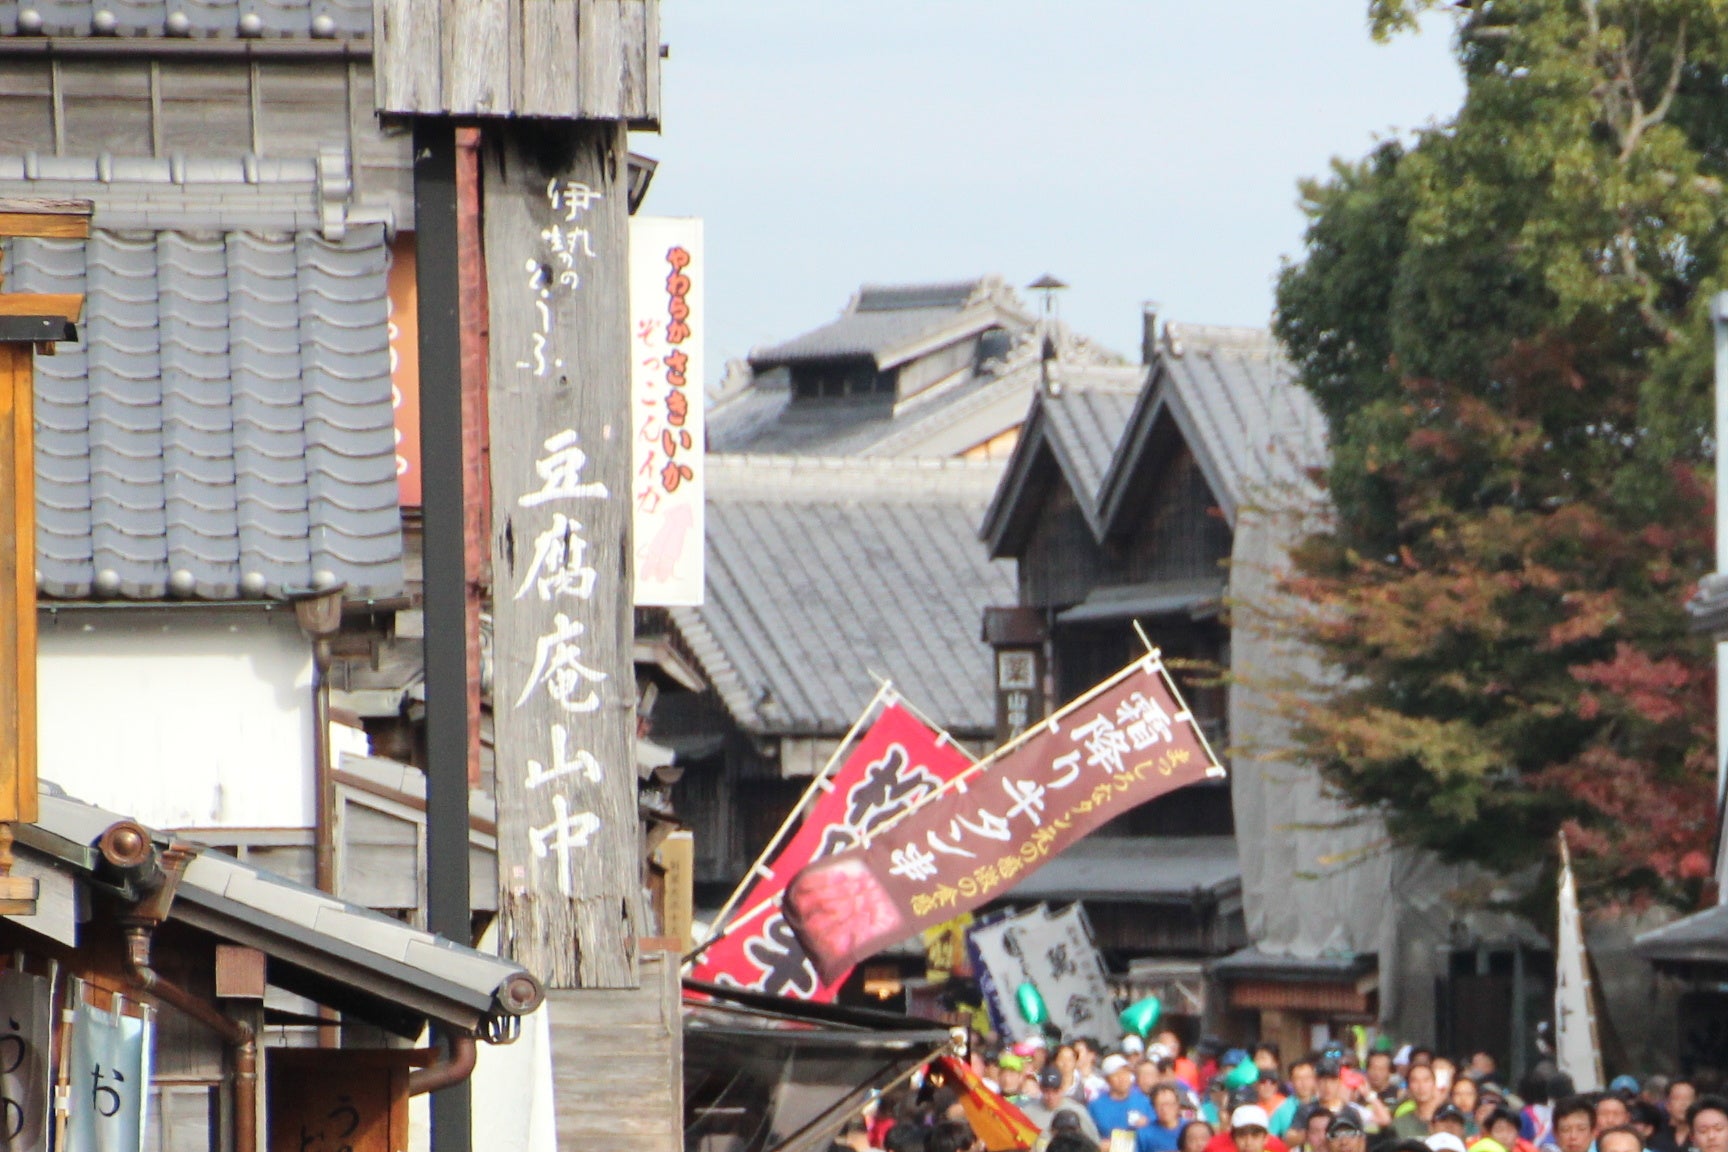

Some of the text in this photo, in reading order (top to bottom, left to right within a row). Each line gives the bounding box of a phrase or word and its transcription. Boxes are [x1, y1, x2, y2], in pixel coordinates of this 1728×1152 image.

[513, 428, 609, 897] 豆腐庵山中
[889, 690, 1174, 883] 霜降り牛タン串
